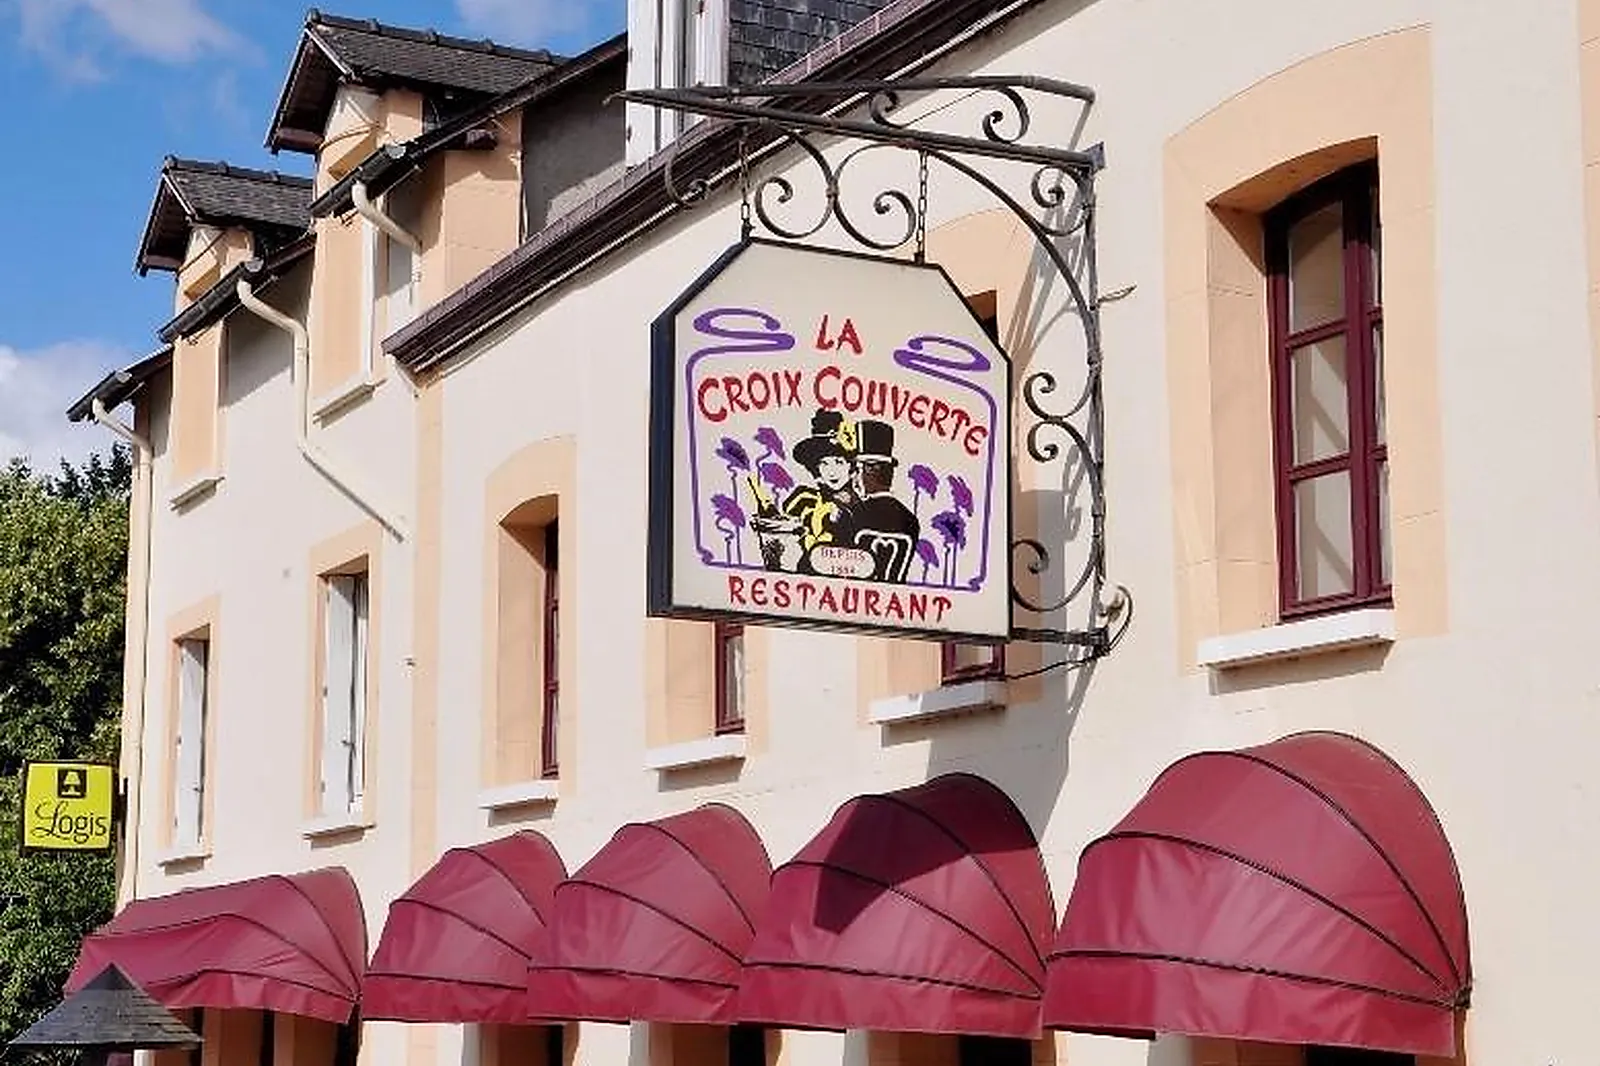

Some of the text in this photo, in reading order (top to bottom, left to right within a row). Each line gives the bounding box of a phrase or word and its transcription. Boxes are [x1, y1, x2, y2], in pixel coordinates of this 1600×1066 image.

[816, 314, 863, 354] LA
[698, 365, 989, 456] CROIX COUVERTE
[728, 575, 953, 622] RESTAURANT
[31, 799, 107, 845] Logis
